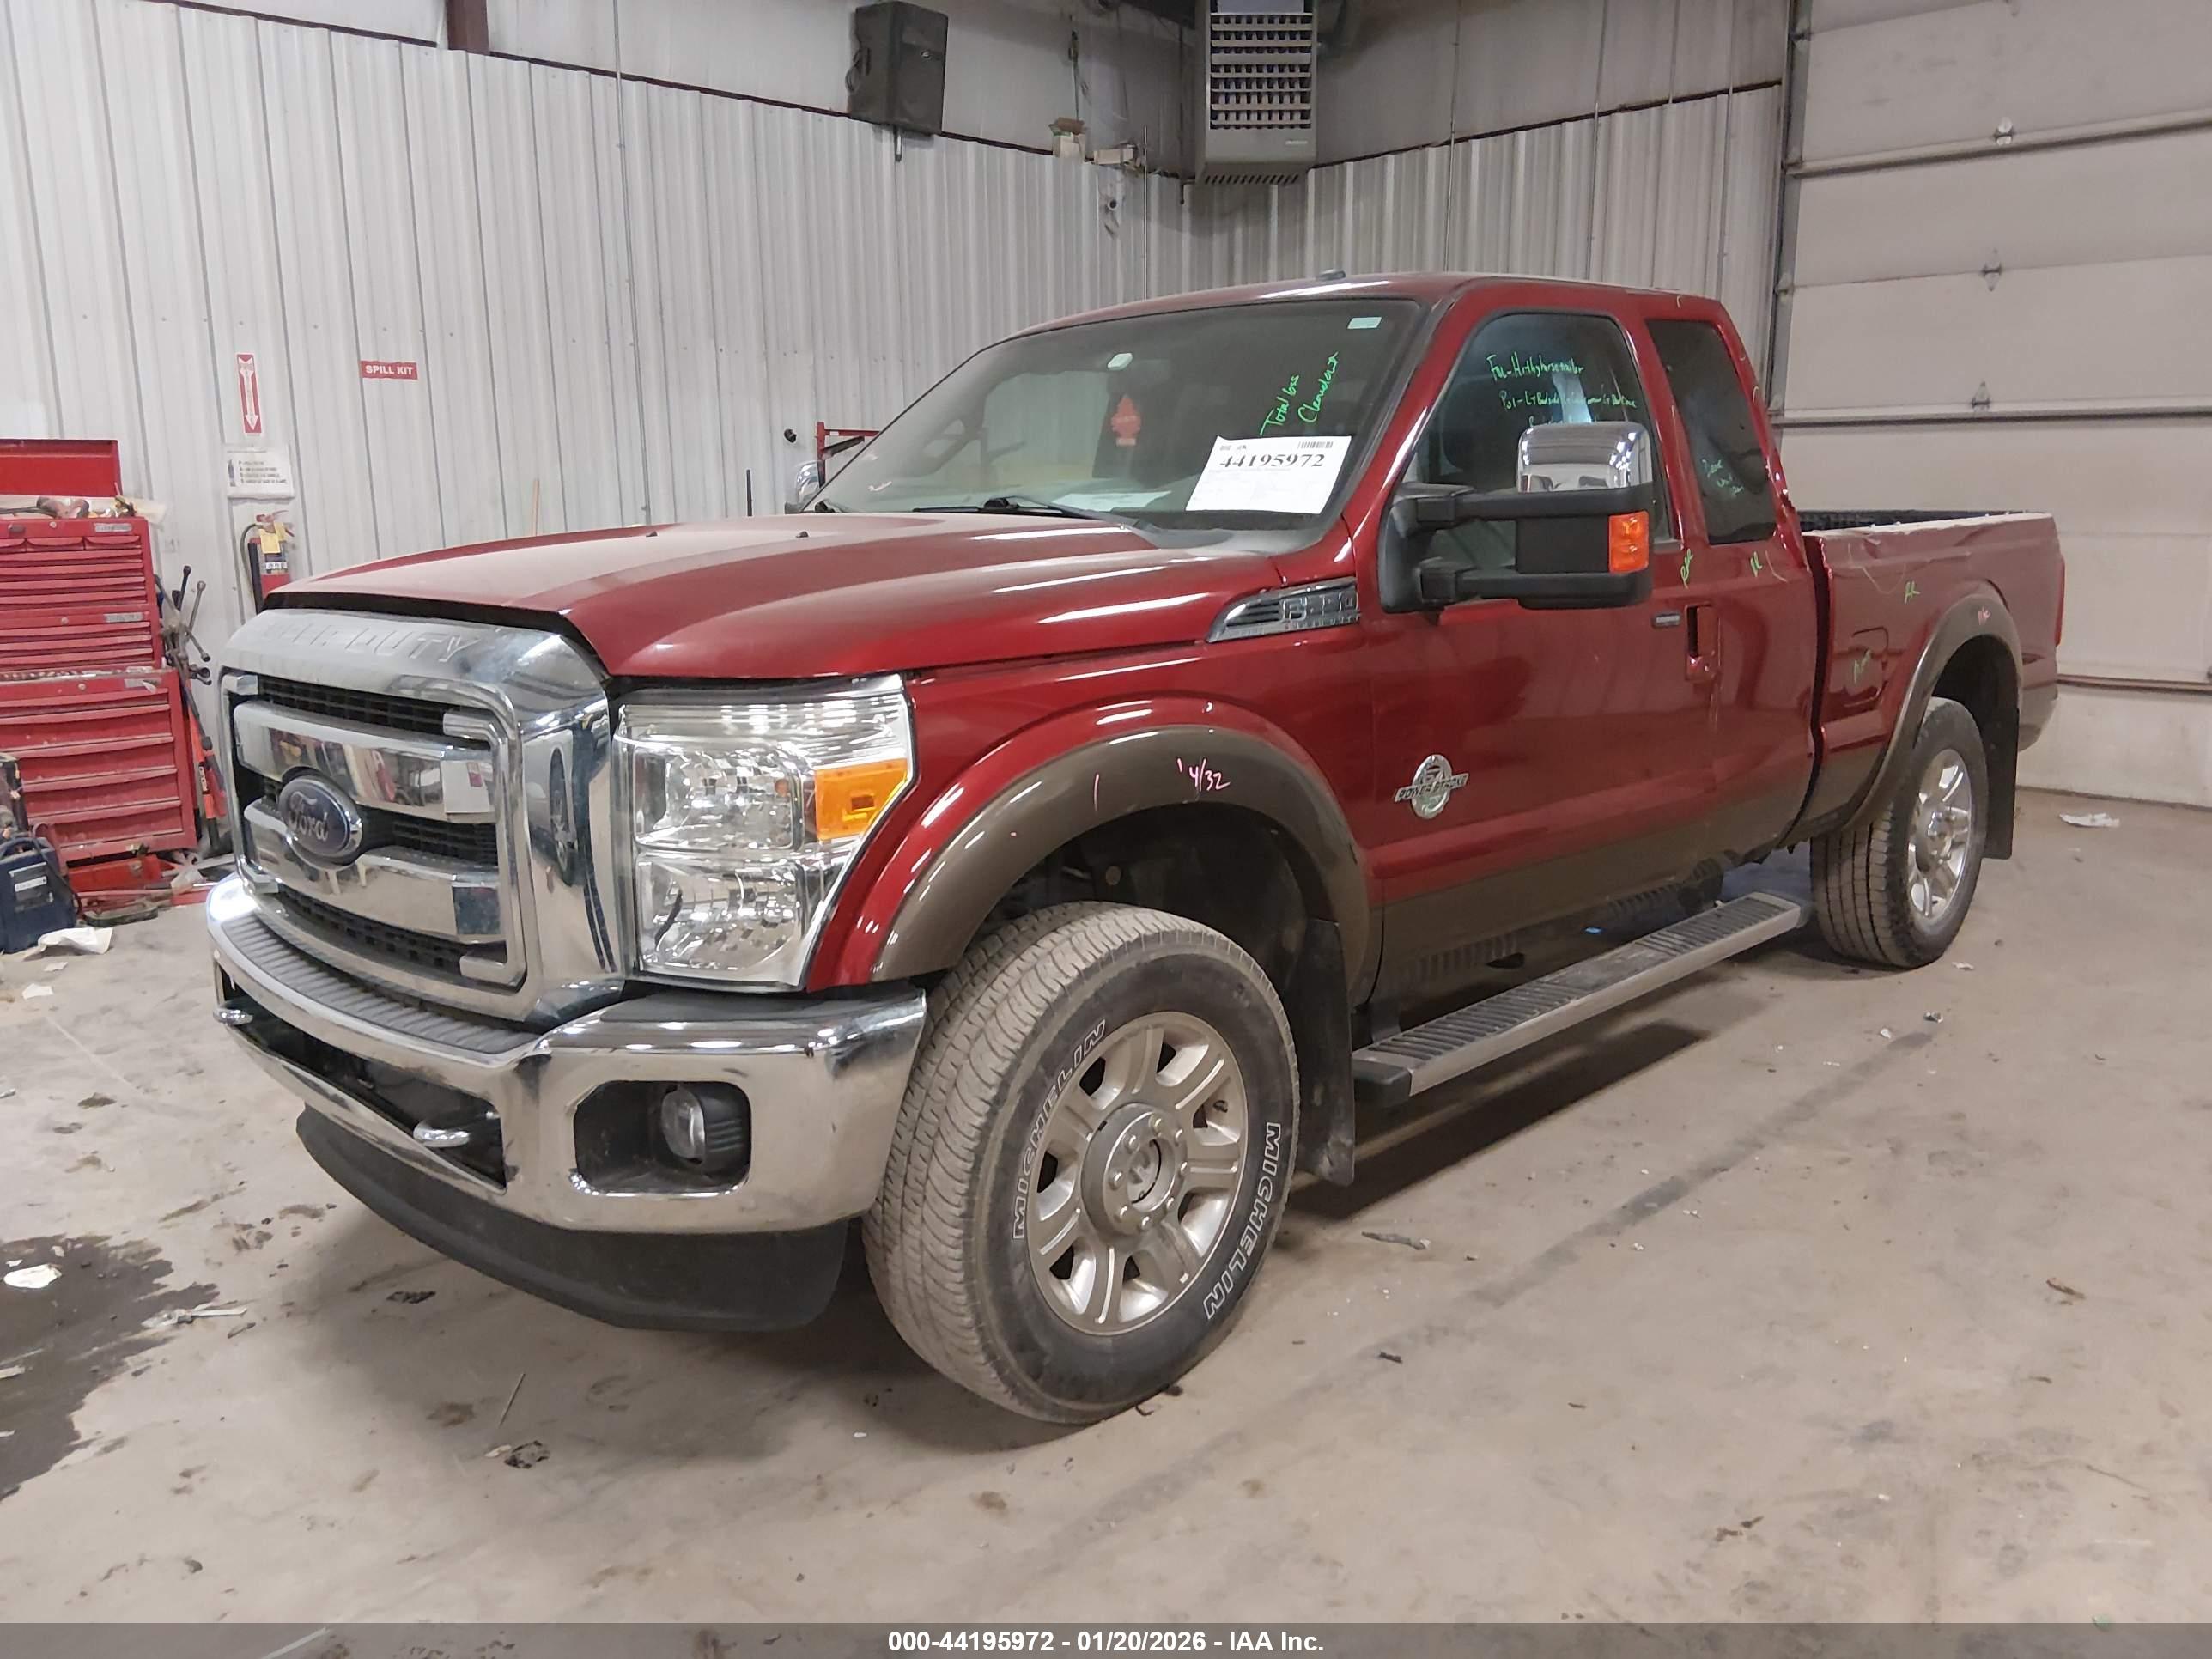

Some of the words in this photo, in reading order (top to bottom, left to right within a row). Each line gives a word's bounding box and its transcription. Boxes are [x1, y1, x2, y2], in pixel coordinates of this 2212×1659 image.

[365, 365, 394, 374] SPILL
[397, 366, 413, 375] KIT
[1260, 396, 1289, 436] Total
[1282, 374, 1299, 397] loss
[1219, 453, 1325, 468] 44195972
[344, 627, 480, 663] DUTY
[289, 791, 330, 842] Ford
[1013, 1019, 1106, 1239] MICHELIN
[1204, 1121, 1282, 1320] MICHELIN
